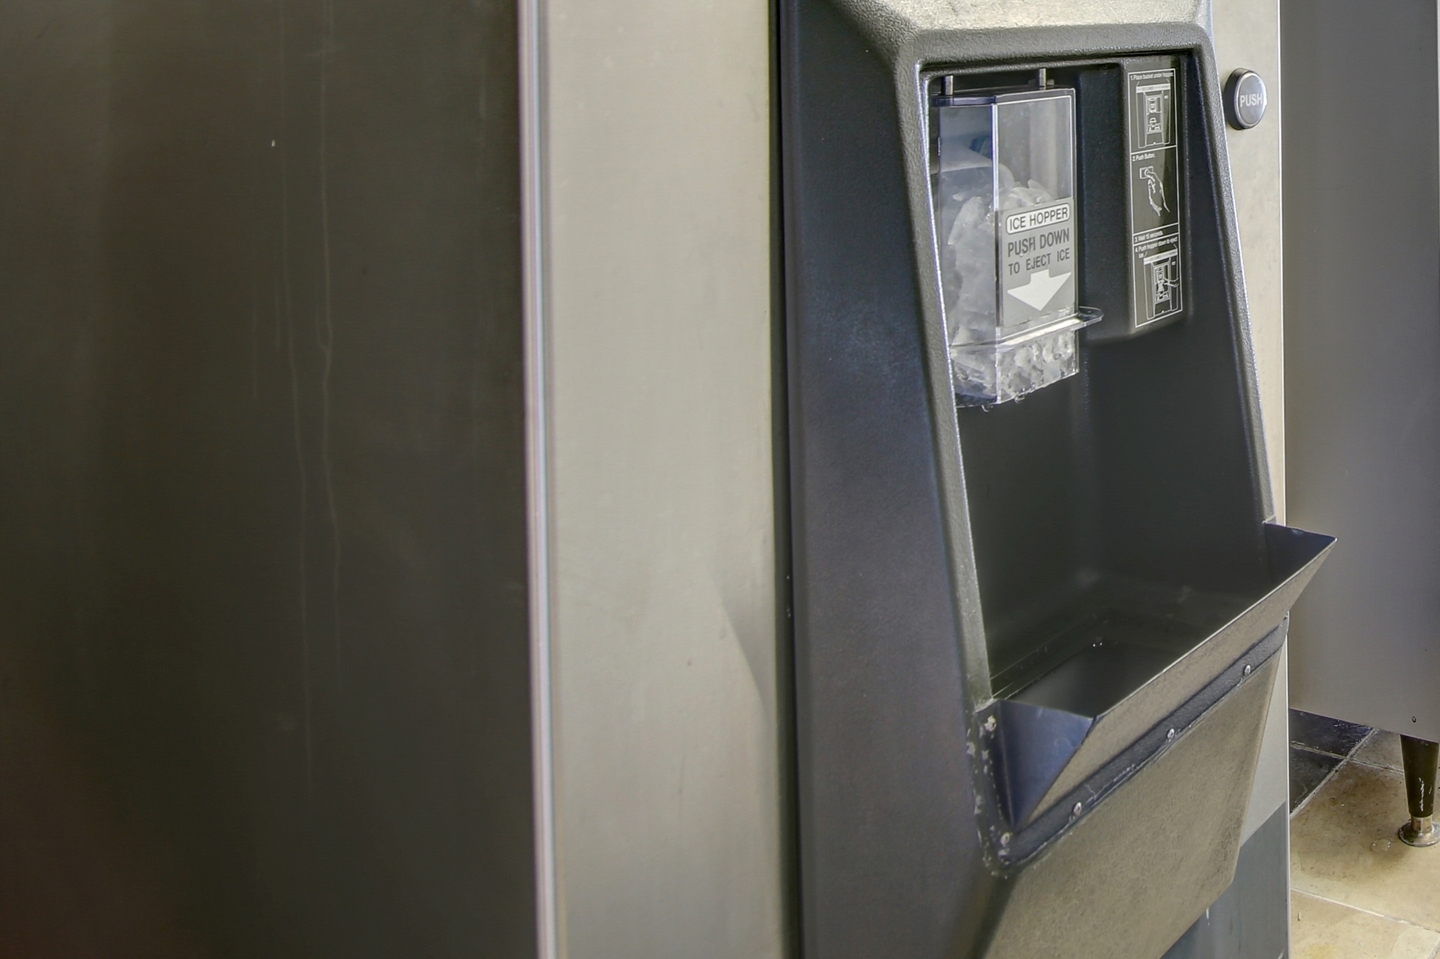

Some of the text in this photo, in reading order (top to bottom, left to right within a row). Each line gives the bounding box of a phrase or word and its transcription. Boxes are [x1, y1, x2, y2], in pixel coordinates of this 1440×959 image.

[1239, 93, 1263, 108] PUSH
[1009, 206, 1068, 231] ICE HOPPER
[1007, 227, 1070, 258] PUSH DOWN
[1008, 247, 1070, 276] TO EJECT ICE
